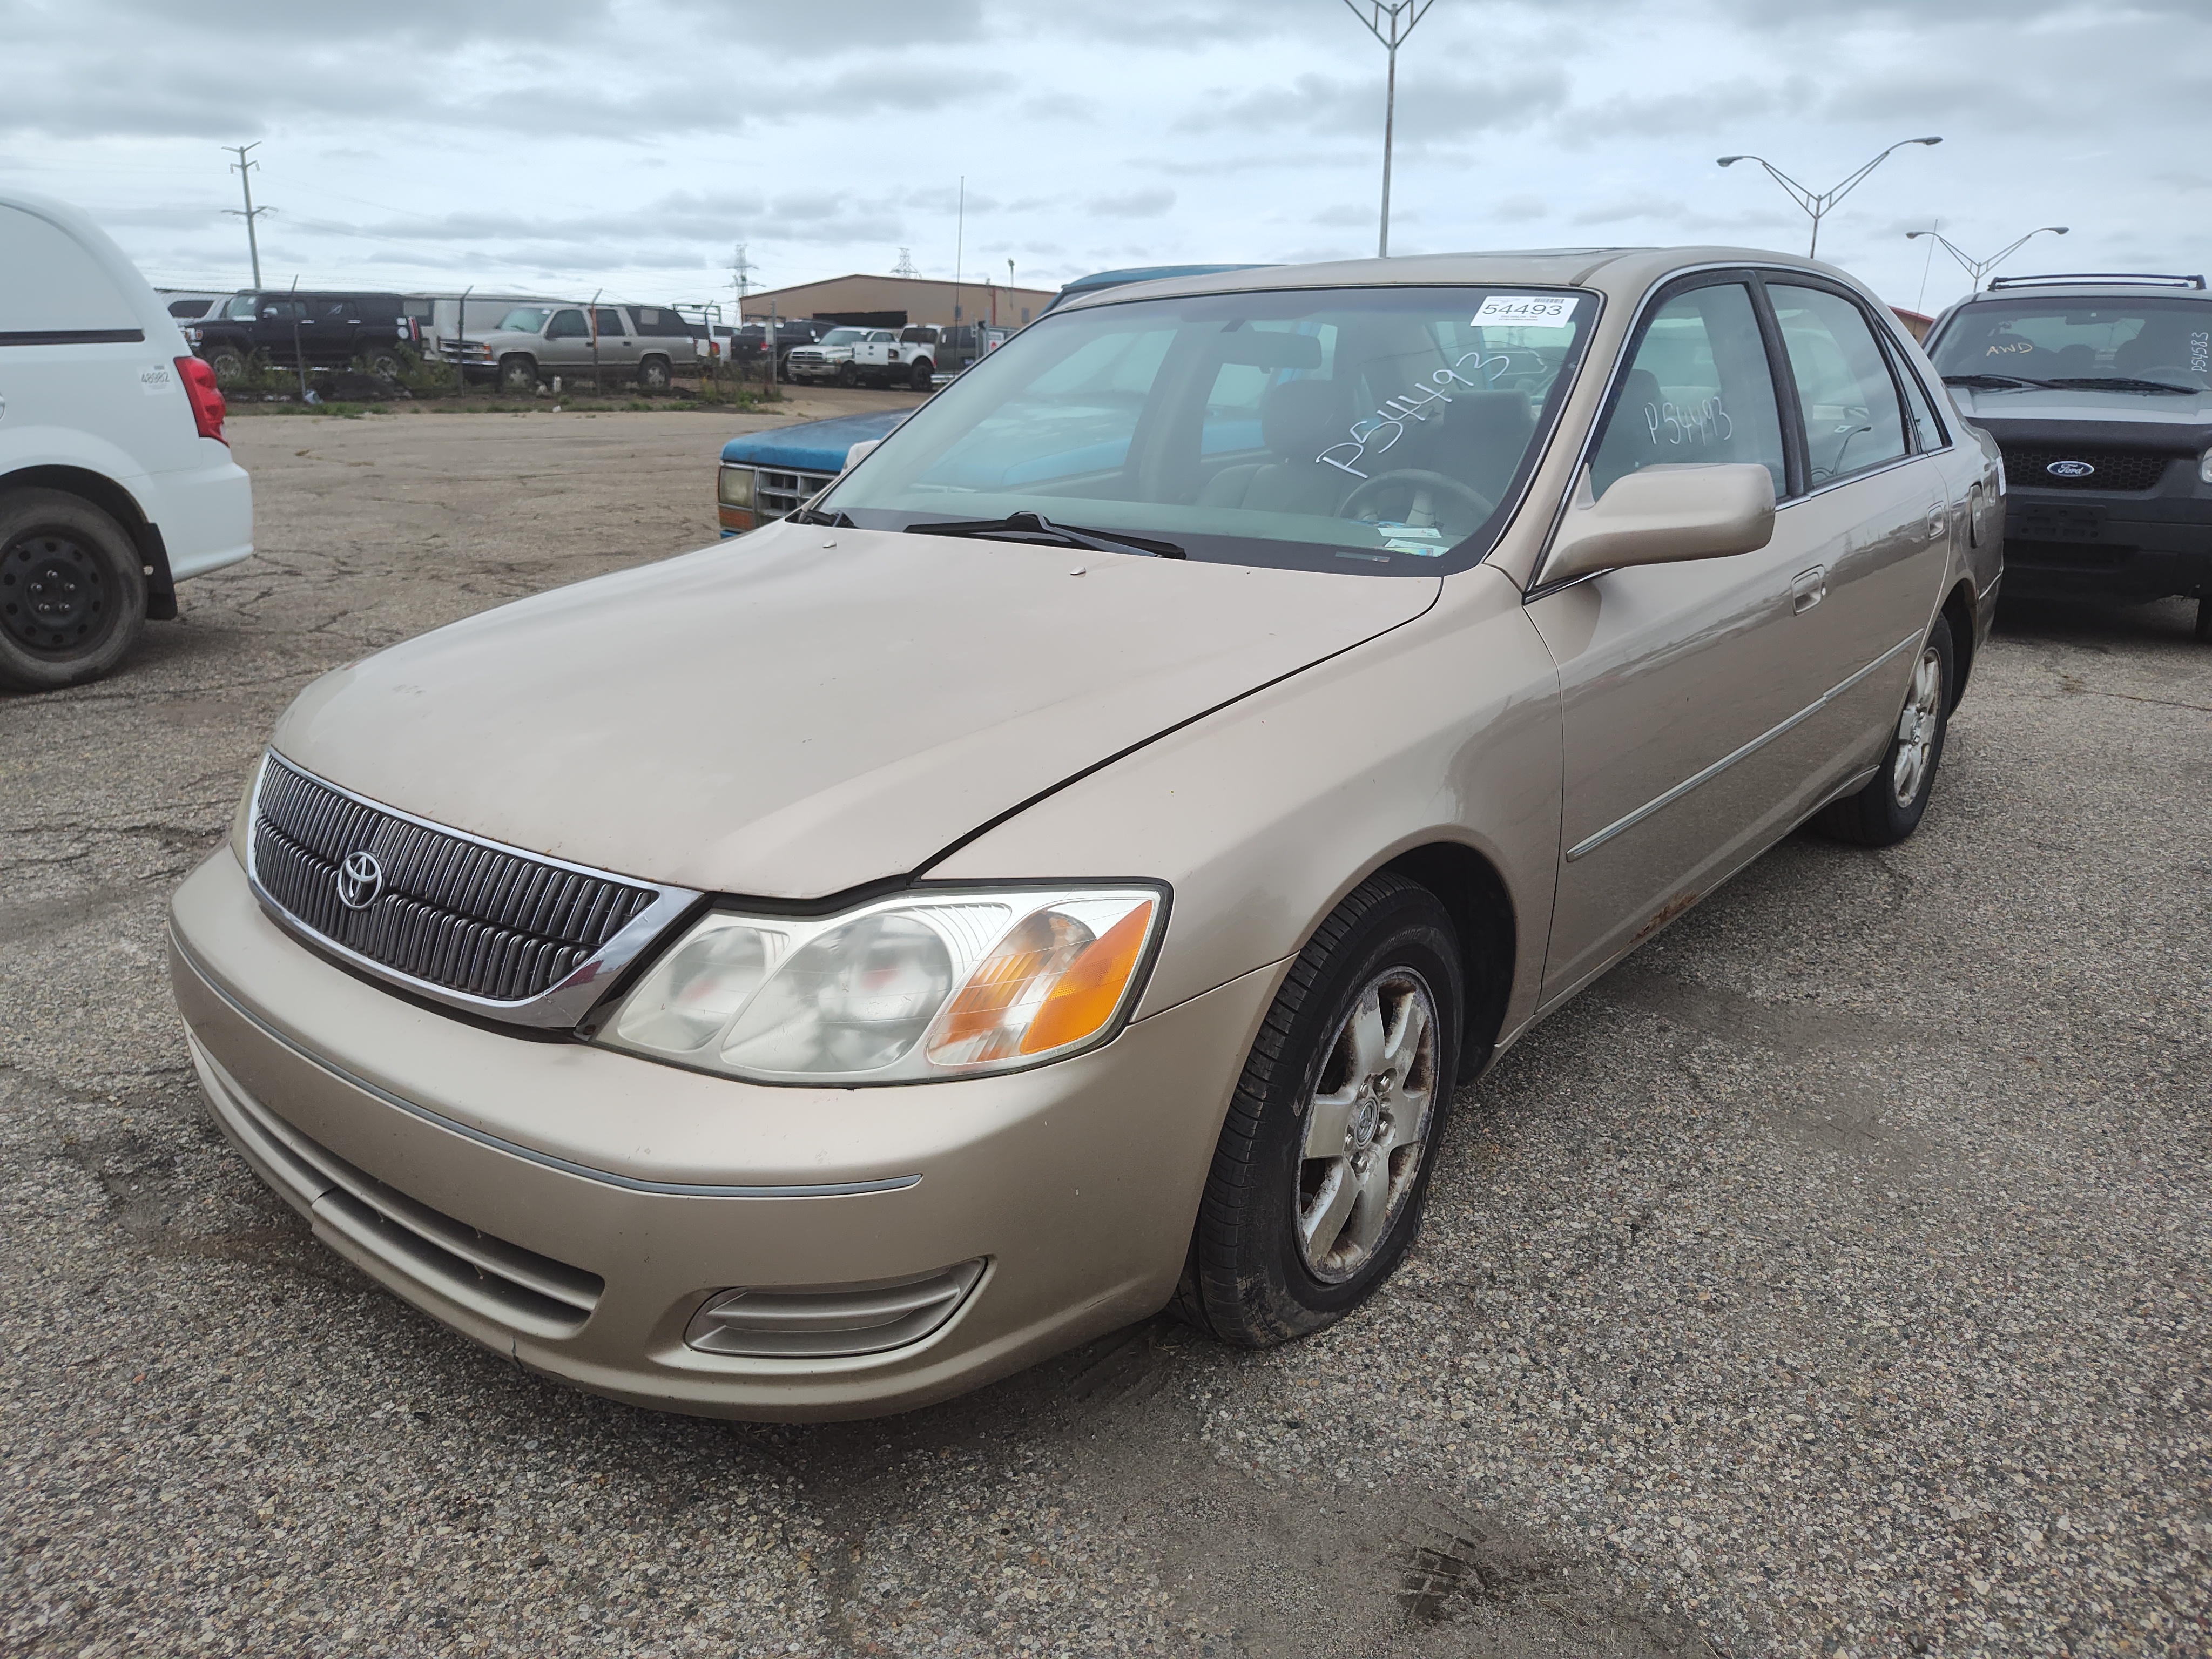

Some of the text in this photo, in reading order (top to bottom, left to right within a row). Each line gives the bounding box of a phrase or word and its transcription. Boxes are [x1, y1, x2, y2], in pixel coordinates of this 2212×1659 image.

[1482, 304, 1562, 316] 54493
[1986, 342, 2033, 356] AWD
[2191, 332, 2209, 372] P54583
[1315, 352, 1510, 478] P54493
[1644, 396, 1732, 446] P54493
[2057, 463, 2084, 474] Ford
